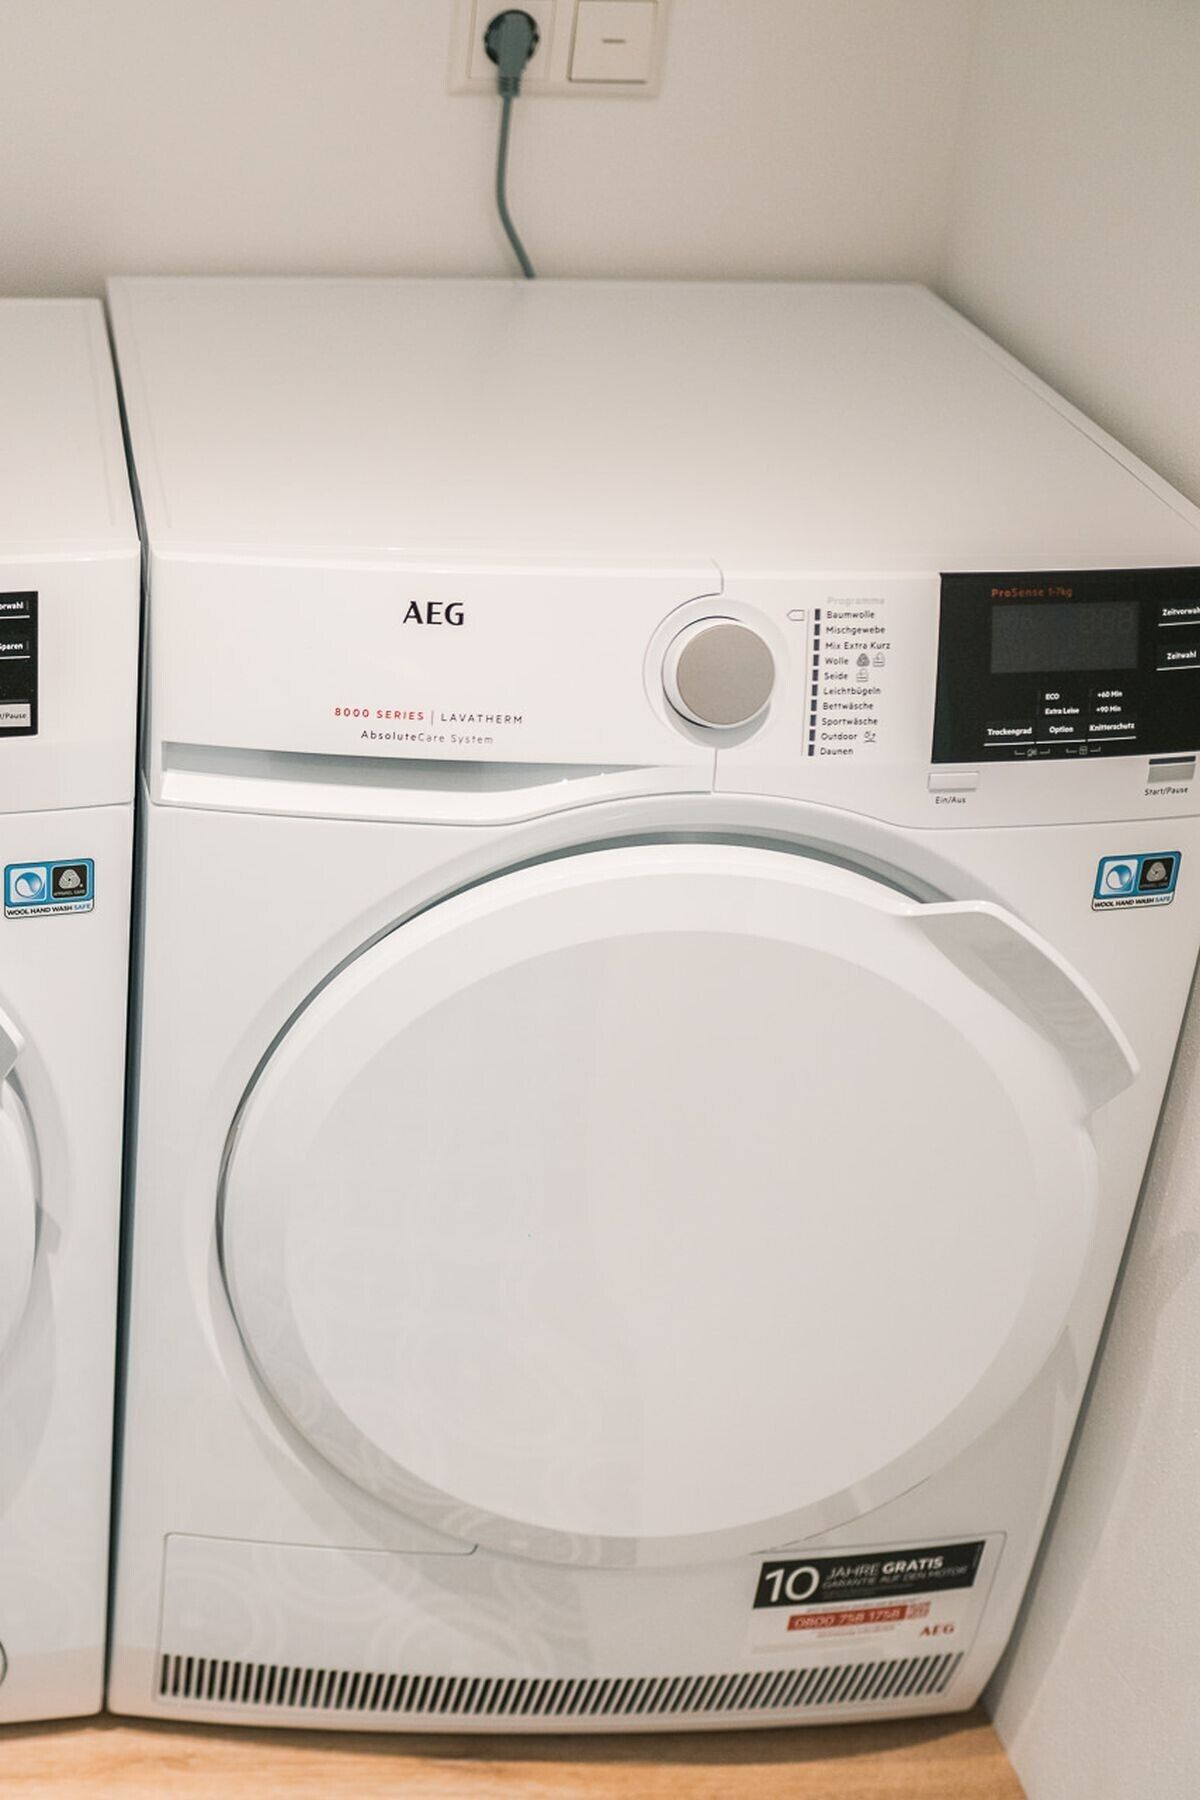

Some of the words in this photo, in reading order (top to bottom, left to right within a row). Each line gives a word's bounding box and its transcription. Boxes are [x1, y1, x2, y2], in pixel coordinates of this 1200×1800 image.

[991, 587, 1045, 598] ProSense
[403, 600, 464, 626] AEG
[826, 610, 875, 619] Baumwolle
[1162, 606, 1200, 616] Zeitvorwah
[826, 626, 886, 636] Mischgewebe
[825, 642, 841, 650] Mix
[844, 641, 868, 650] Extra
[870, 641, 891, 650] Kurz
[1166, 650, 1197, 660] Zeitwahl
[824, 657, 849, 665] Wolle
[824, 672, 848, 680] Seide
[823, 686, 882, 697] Leichtbügeln
[1111, 690, 1123, 698] Min
[822, 702, 874, 710] Bettwäsche
[1045, 707, 1062, 715] Extra
[1063, 706, 1080, 714] Leise
[1109, 705, 1121, 713] Min
[334, 707, 370, 718] 8000
[376, 709, 425, 721] SERIES
[440, 712, 523, 725] LAVATHERM
[821, 717, 878, 727] Sportwäsche
[1089, 722, 1135, 732] Knitterschutz
[987, 727, 1032, 737] Trockengrad
[1049, 725, 1074, 734] Option
[360, 729, 445, 744] AbsoluteCare
[450, 733, 493, 746] System
[821, 732, 857, 741] Outdoor
[820, 747, 854, 756] Daunen
[1144, 786, 1188, 797] Start/Pause
[935, 795, 966, 805] Ein/Aus
[7, 908, 29, 916] WOOL
[765, 1564, 820, 1602] 10
[829, 1563, 879, 1579] JAHRE
[882, 1555, 944, 1575] GRATIS
[920, 1623, 955, 1637] AEG
